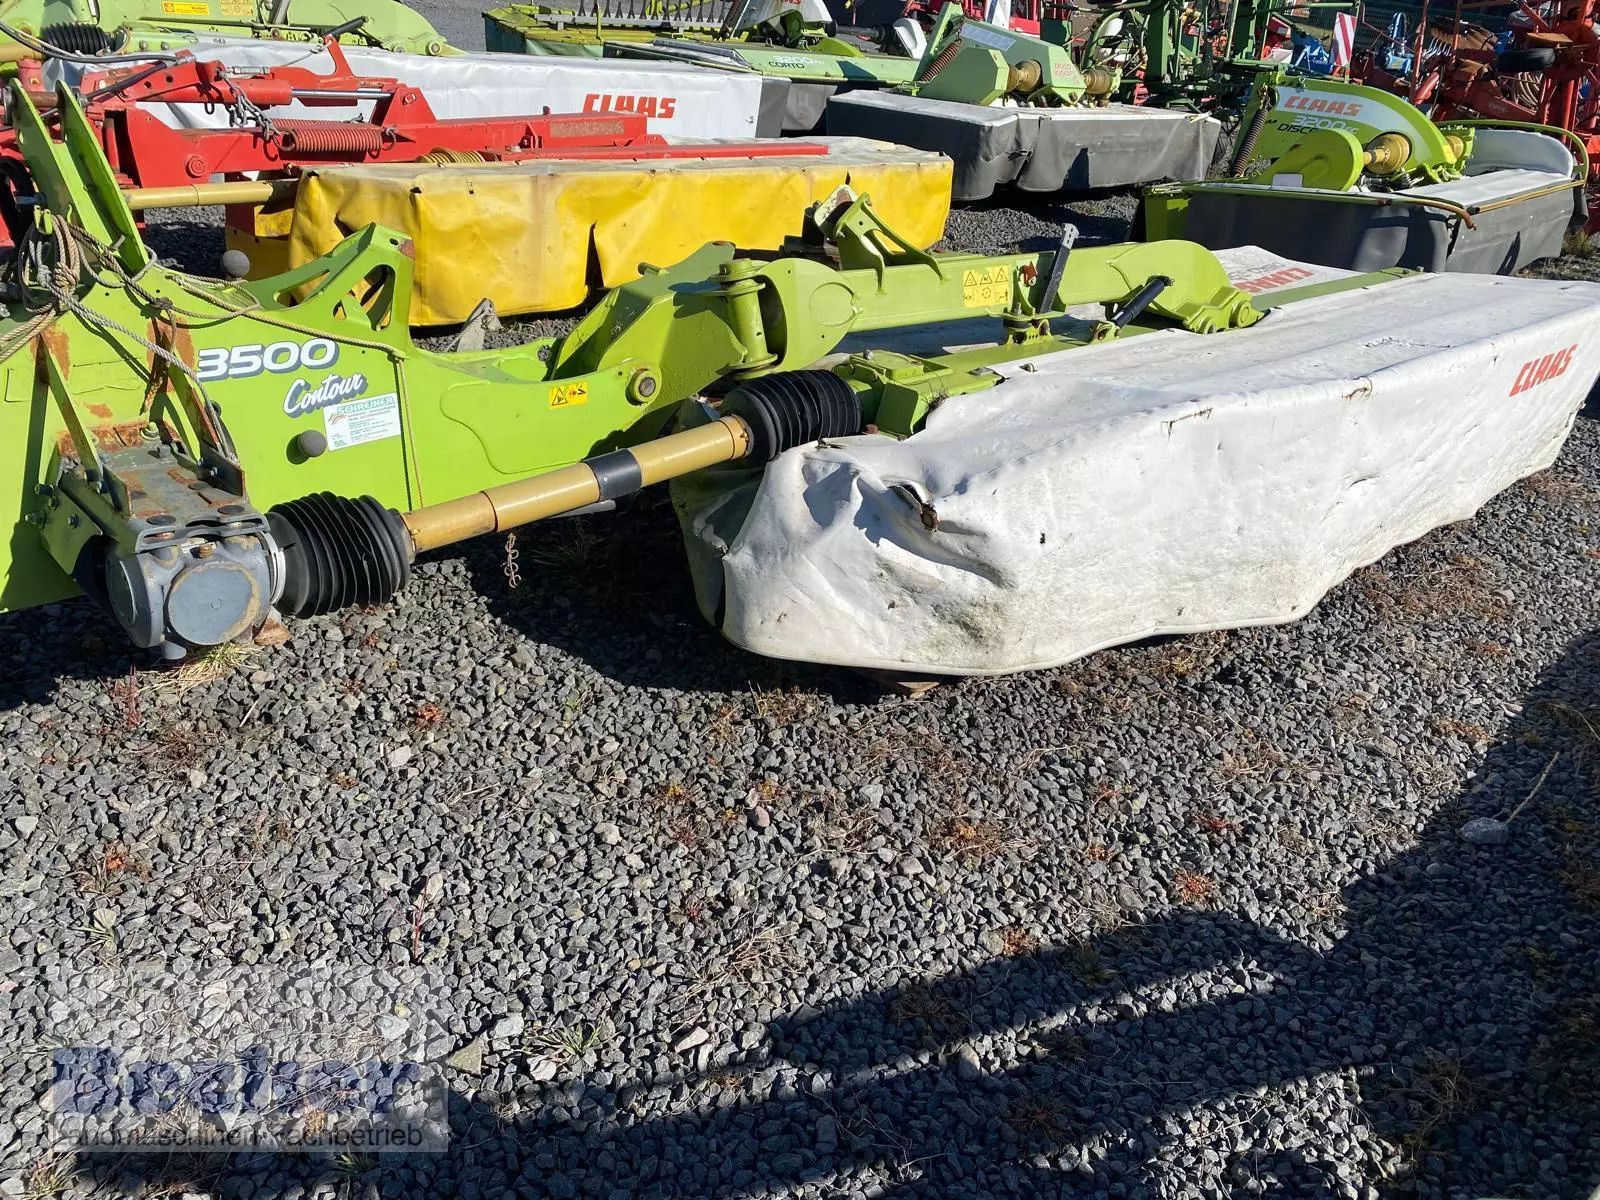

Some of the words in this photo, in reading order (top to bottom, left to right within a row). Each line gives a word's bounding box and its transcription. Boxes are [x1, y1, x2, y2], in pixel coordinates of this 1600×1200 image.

[768, 61, 805, 69] CORTO
[583, 94, 676, 118] CLAAS
[1284, 95, 1363, 117] CLAAS
[197, 338, 339, 381] 3500
[1509, 344, 1579, 397] CLAAS
[283, 373, 368, 418] Contour
[336, 396, 396, 413] SCHREINER
